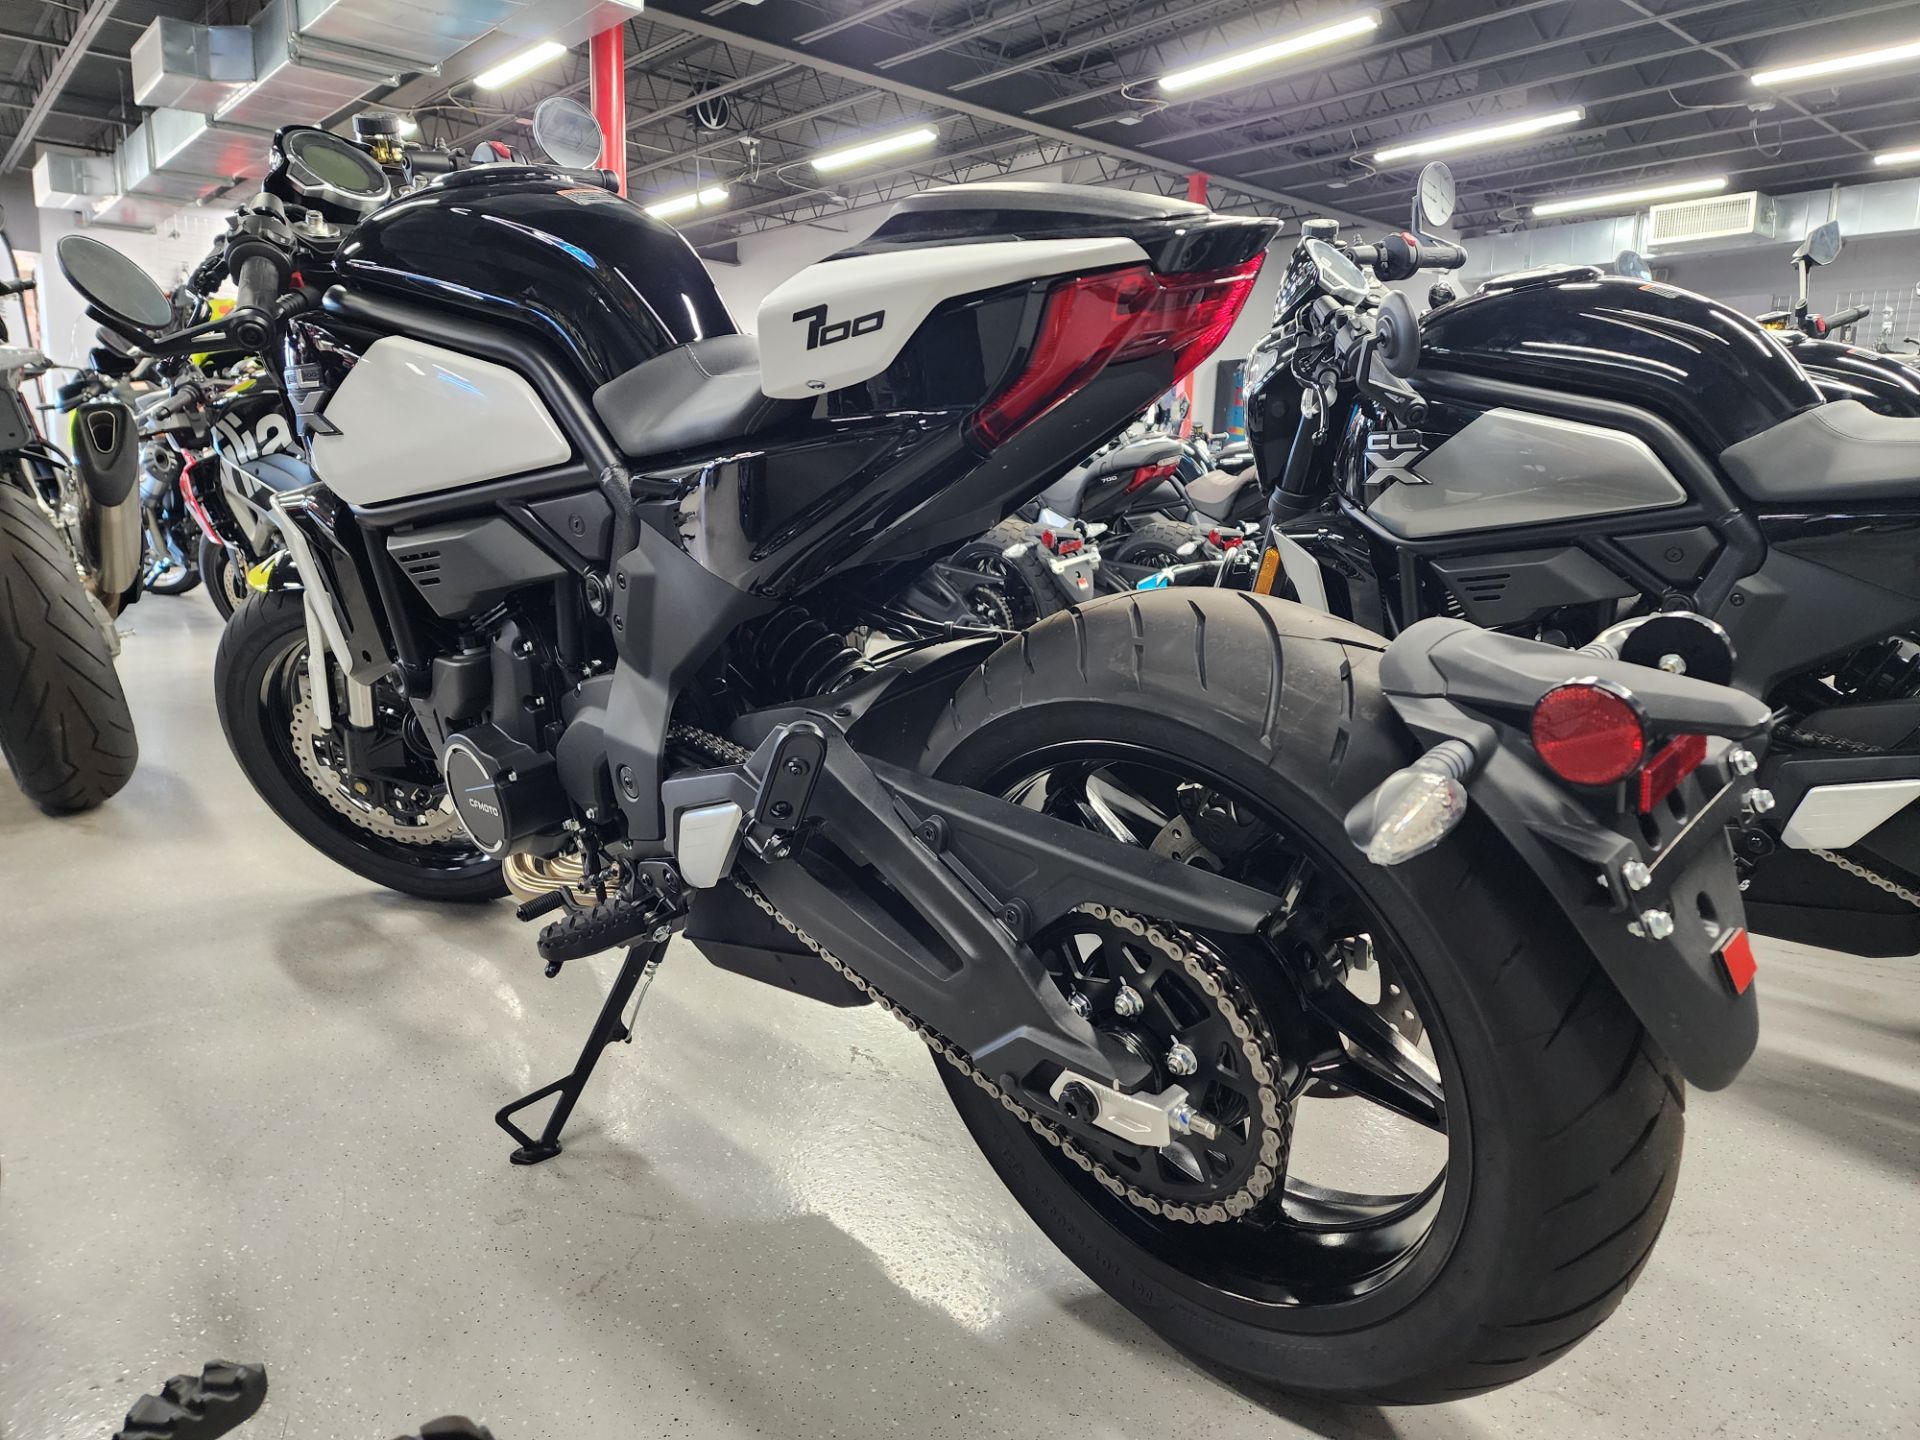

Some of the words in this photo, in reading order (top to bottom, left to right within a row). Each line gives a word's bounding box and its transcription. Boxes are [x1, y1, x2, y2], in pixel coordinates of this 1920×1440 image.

[792, 303, 885, 351] 700
[1368, 433, 1418, 450] CL
[1364, 450, 1424, 484] X
[469, 798, 499, 817] CFMOTO
